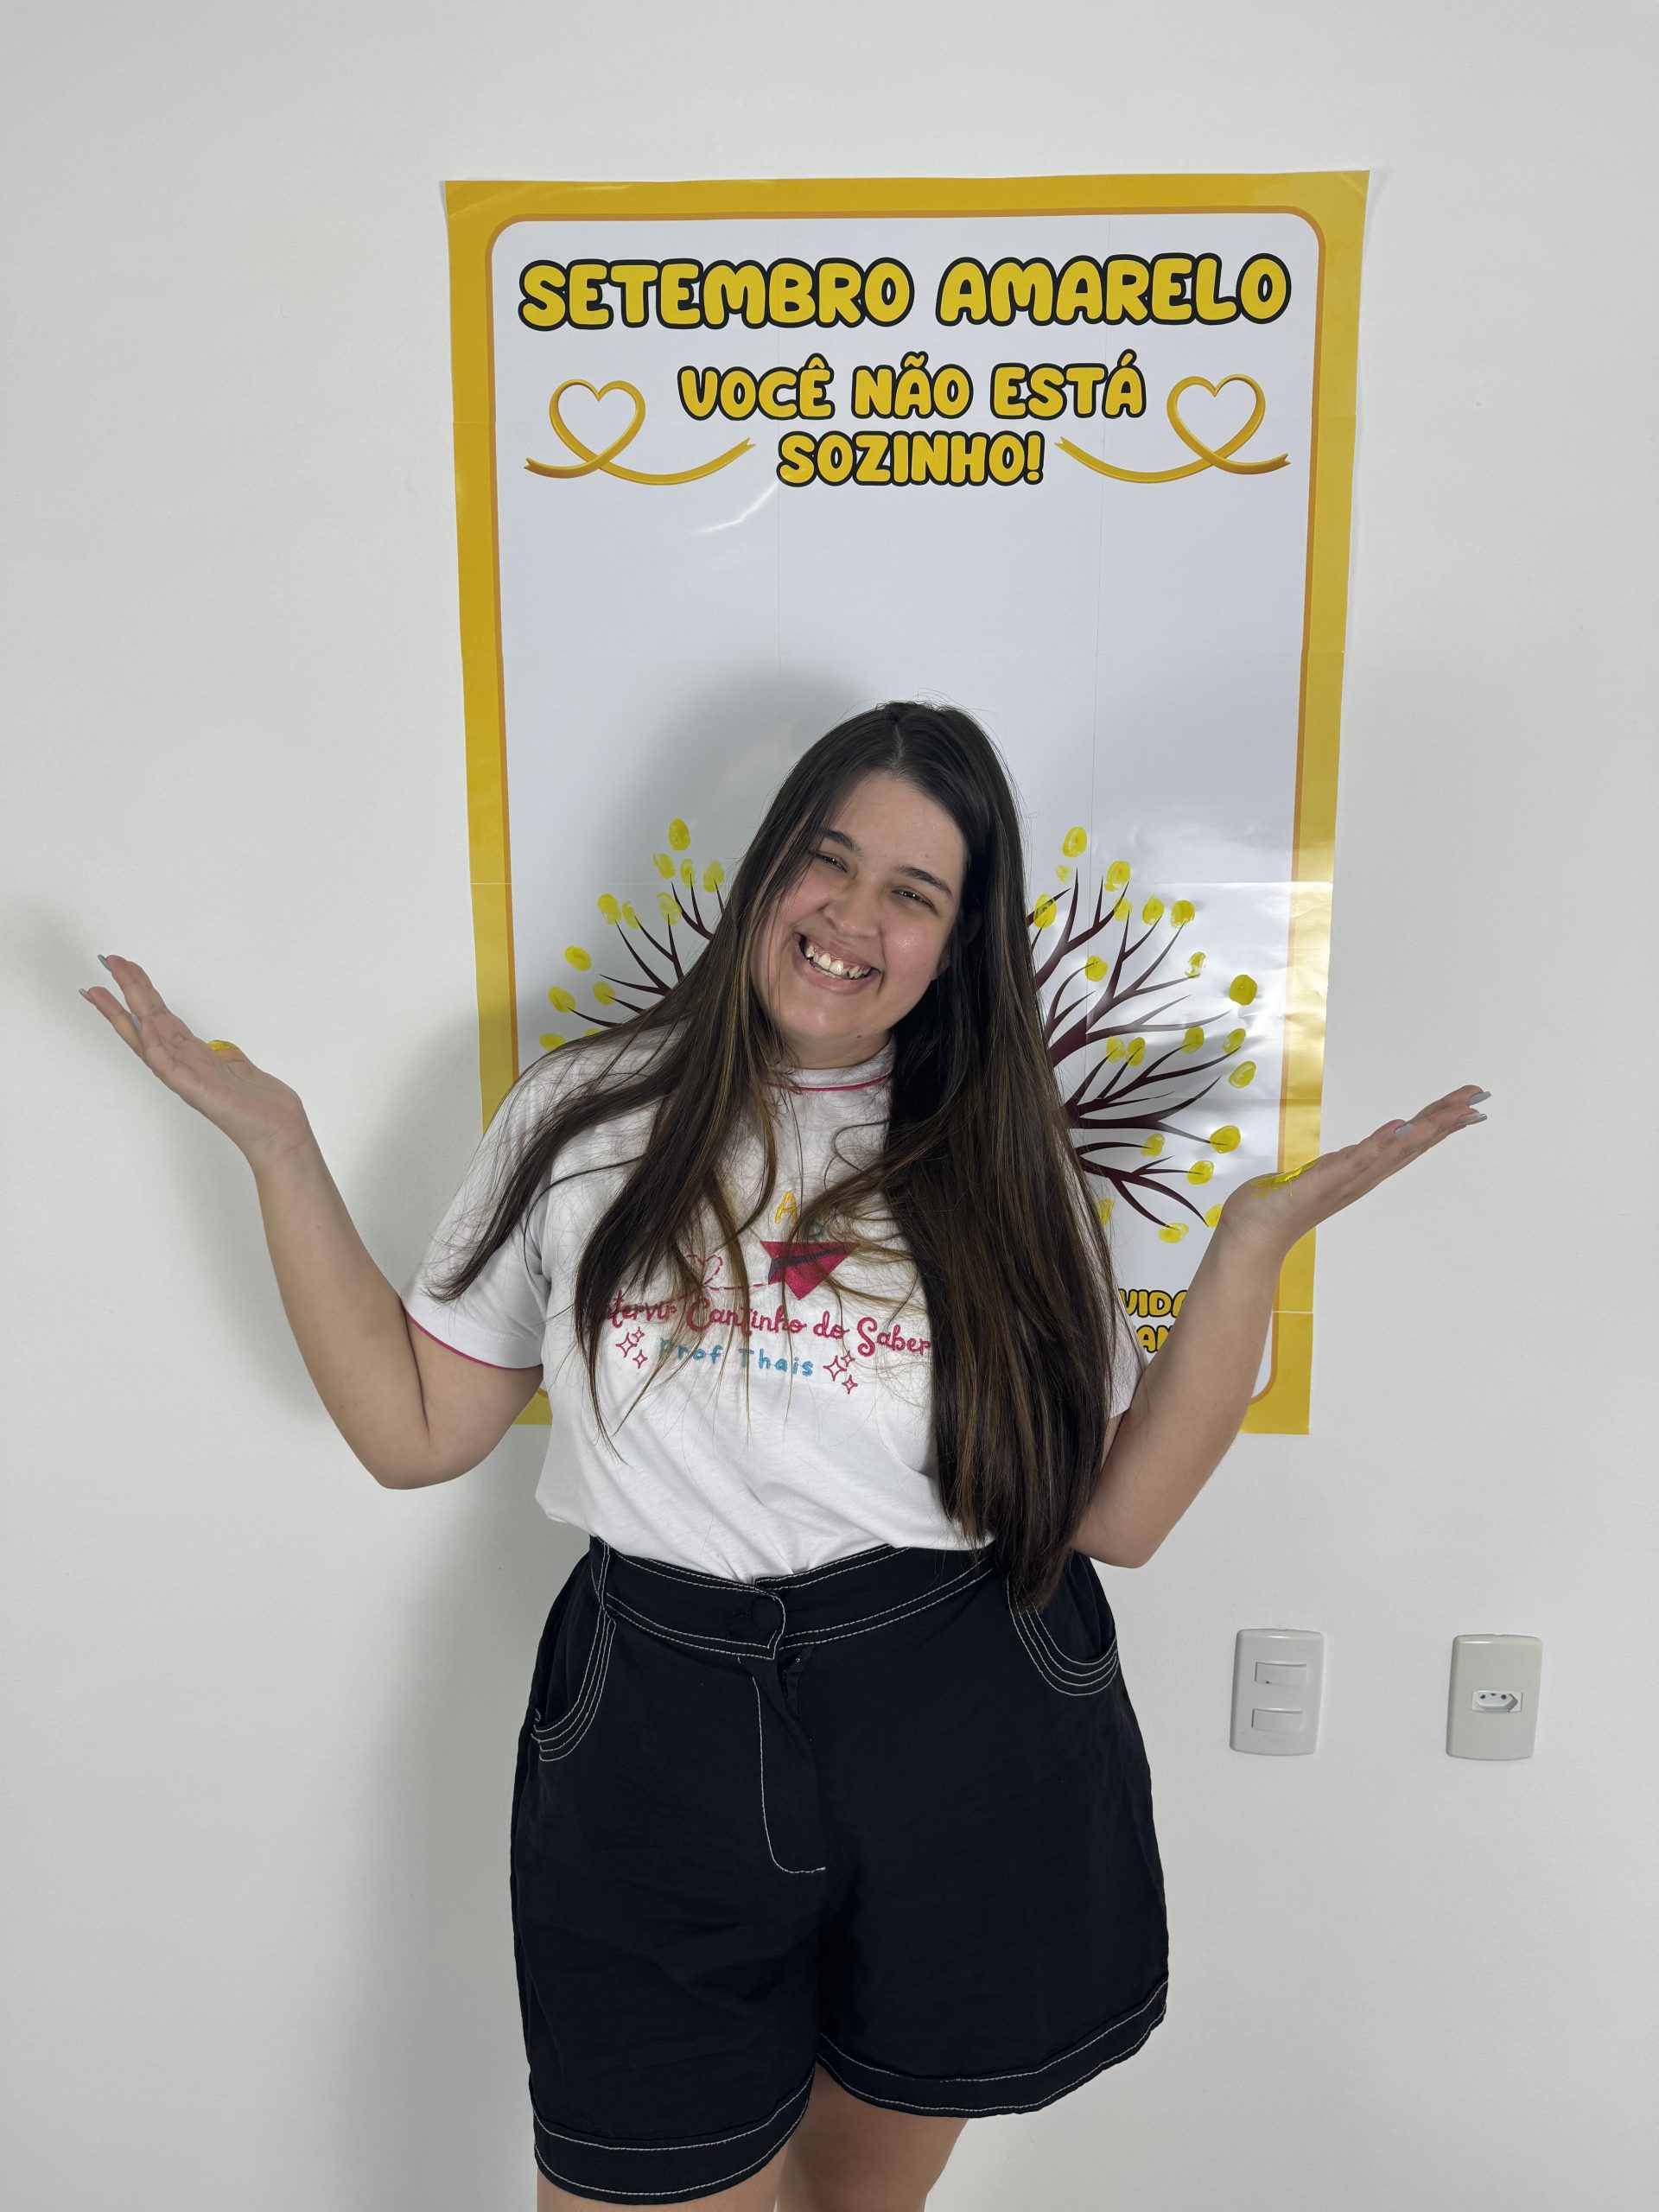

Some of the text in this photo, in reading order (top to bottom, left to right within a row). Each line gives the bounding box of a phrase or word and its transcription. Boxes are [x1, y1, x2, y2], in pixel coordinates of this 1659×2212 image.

[518, 252, 1292, 331] SETEMBRO AMARELO
[677, 348, 1147, 420] VOCÊ NÃO ESTÁ
[777, 430, 1045, 487] SOZINHO!
[687, 1298, 808, 1337] Cantinho
[813, 1311, 850, 1339] do
[856, 1316, 931, 1357] Saber
[738, 1348, 814, 1377] Thais
